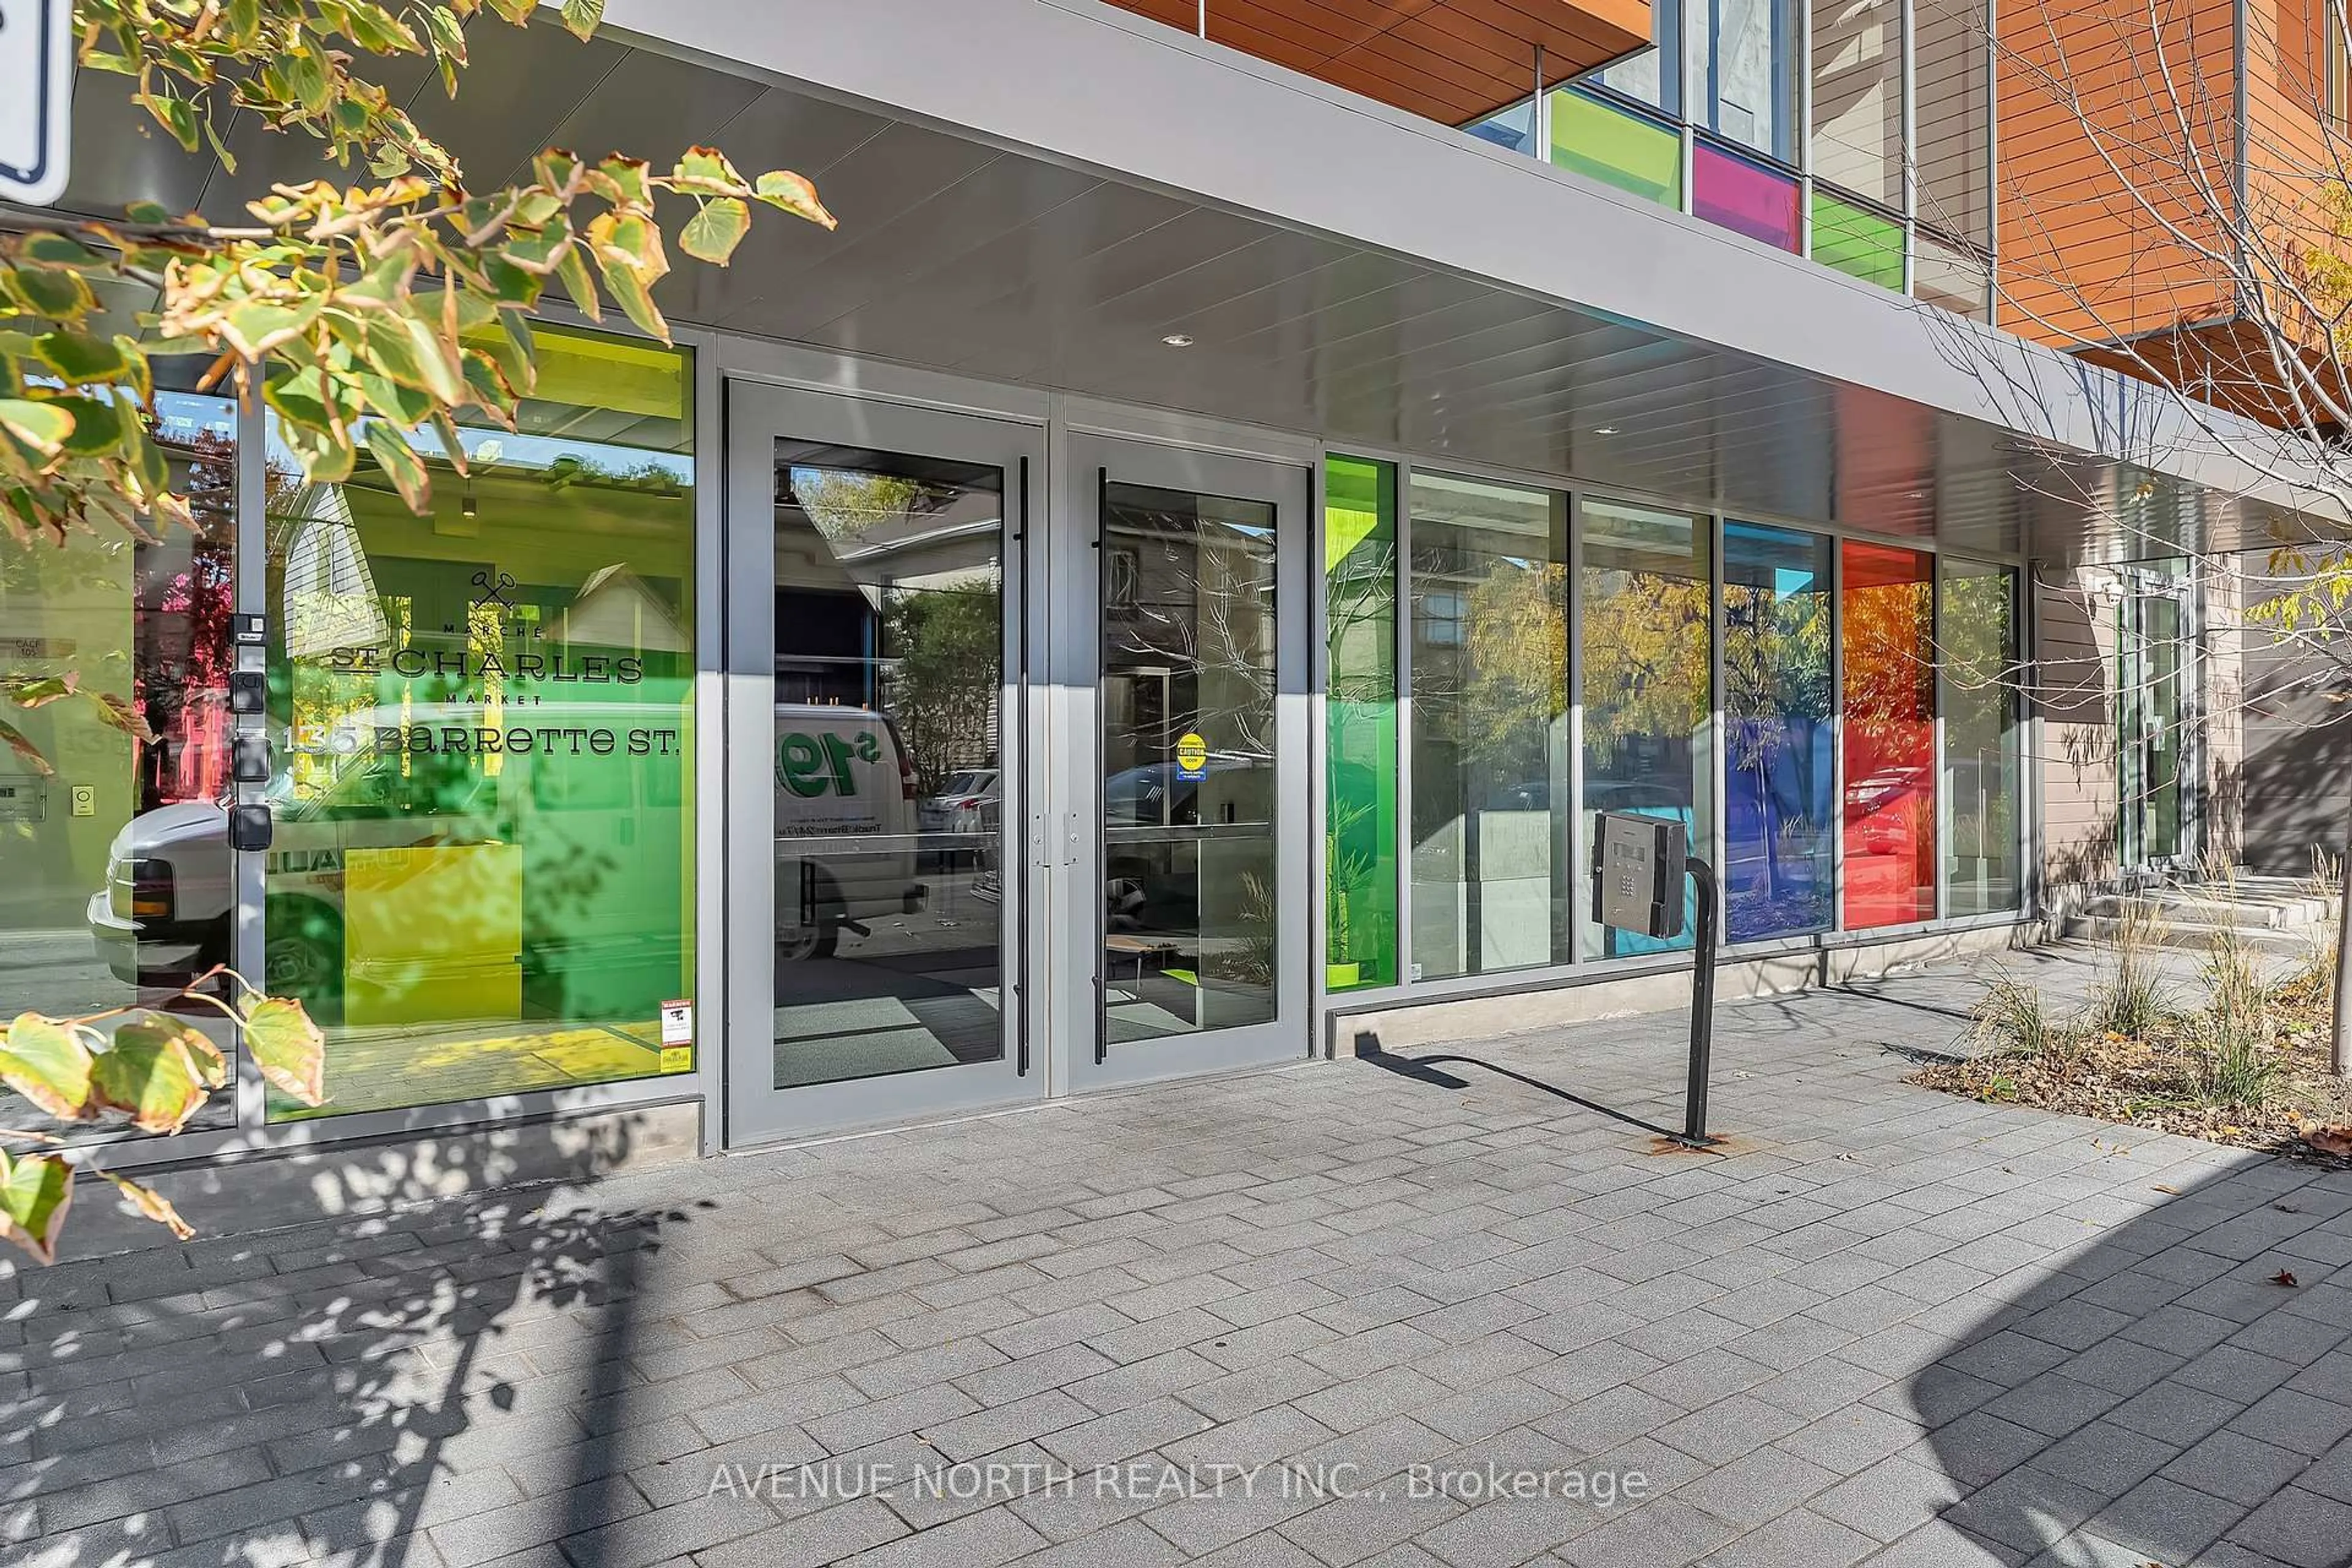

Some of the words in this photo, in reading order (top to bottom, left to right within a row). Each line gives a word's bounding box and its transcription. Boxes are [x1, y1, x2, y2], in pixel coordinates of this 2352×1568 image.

[443, 624, 541, 638] MARCHÉ
[393, 649, 643, 685] CHARLES
[445, 693, 541, 706] MARKET
[628, 728, 680, 756] ST.
